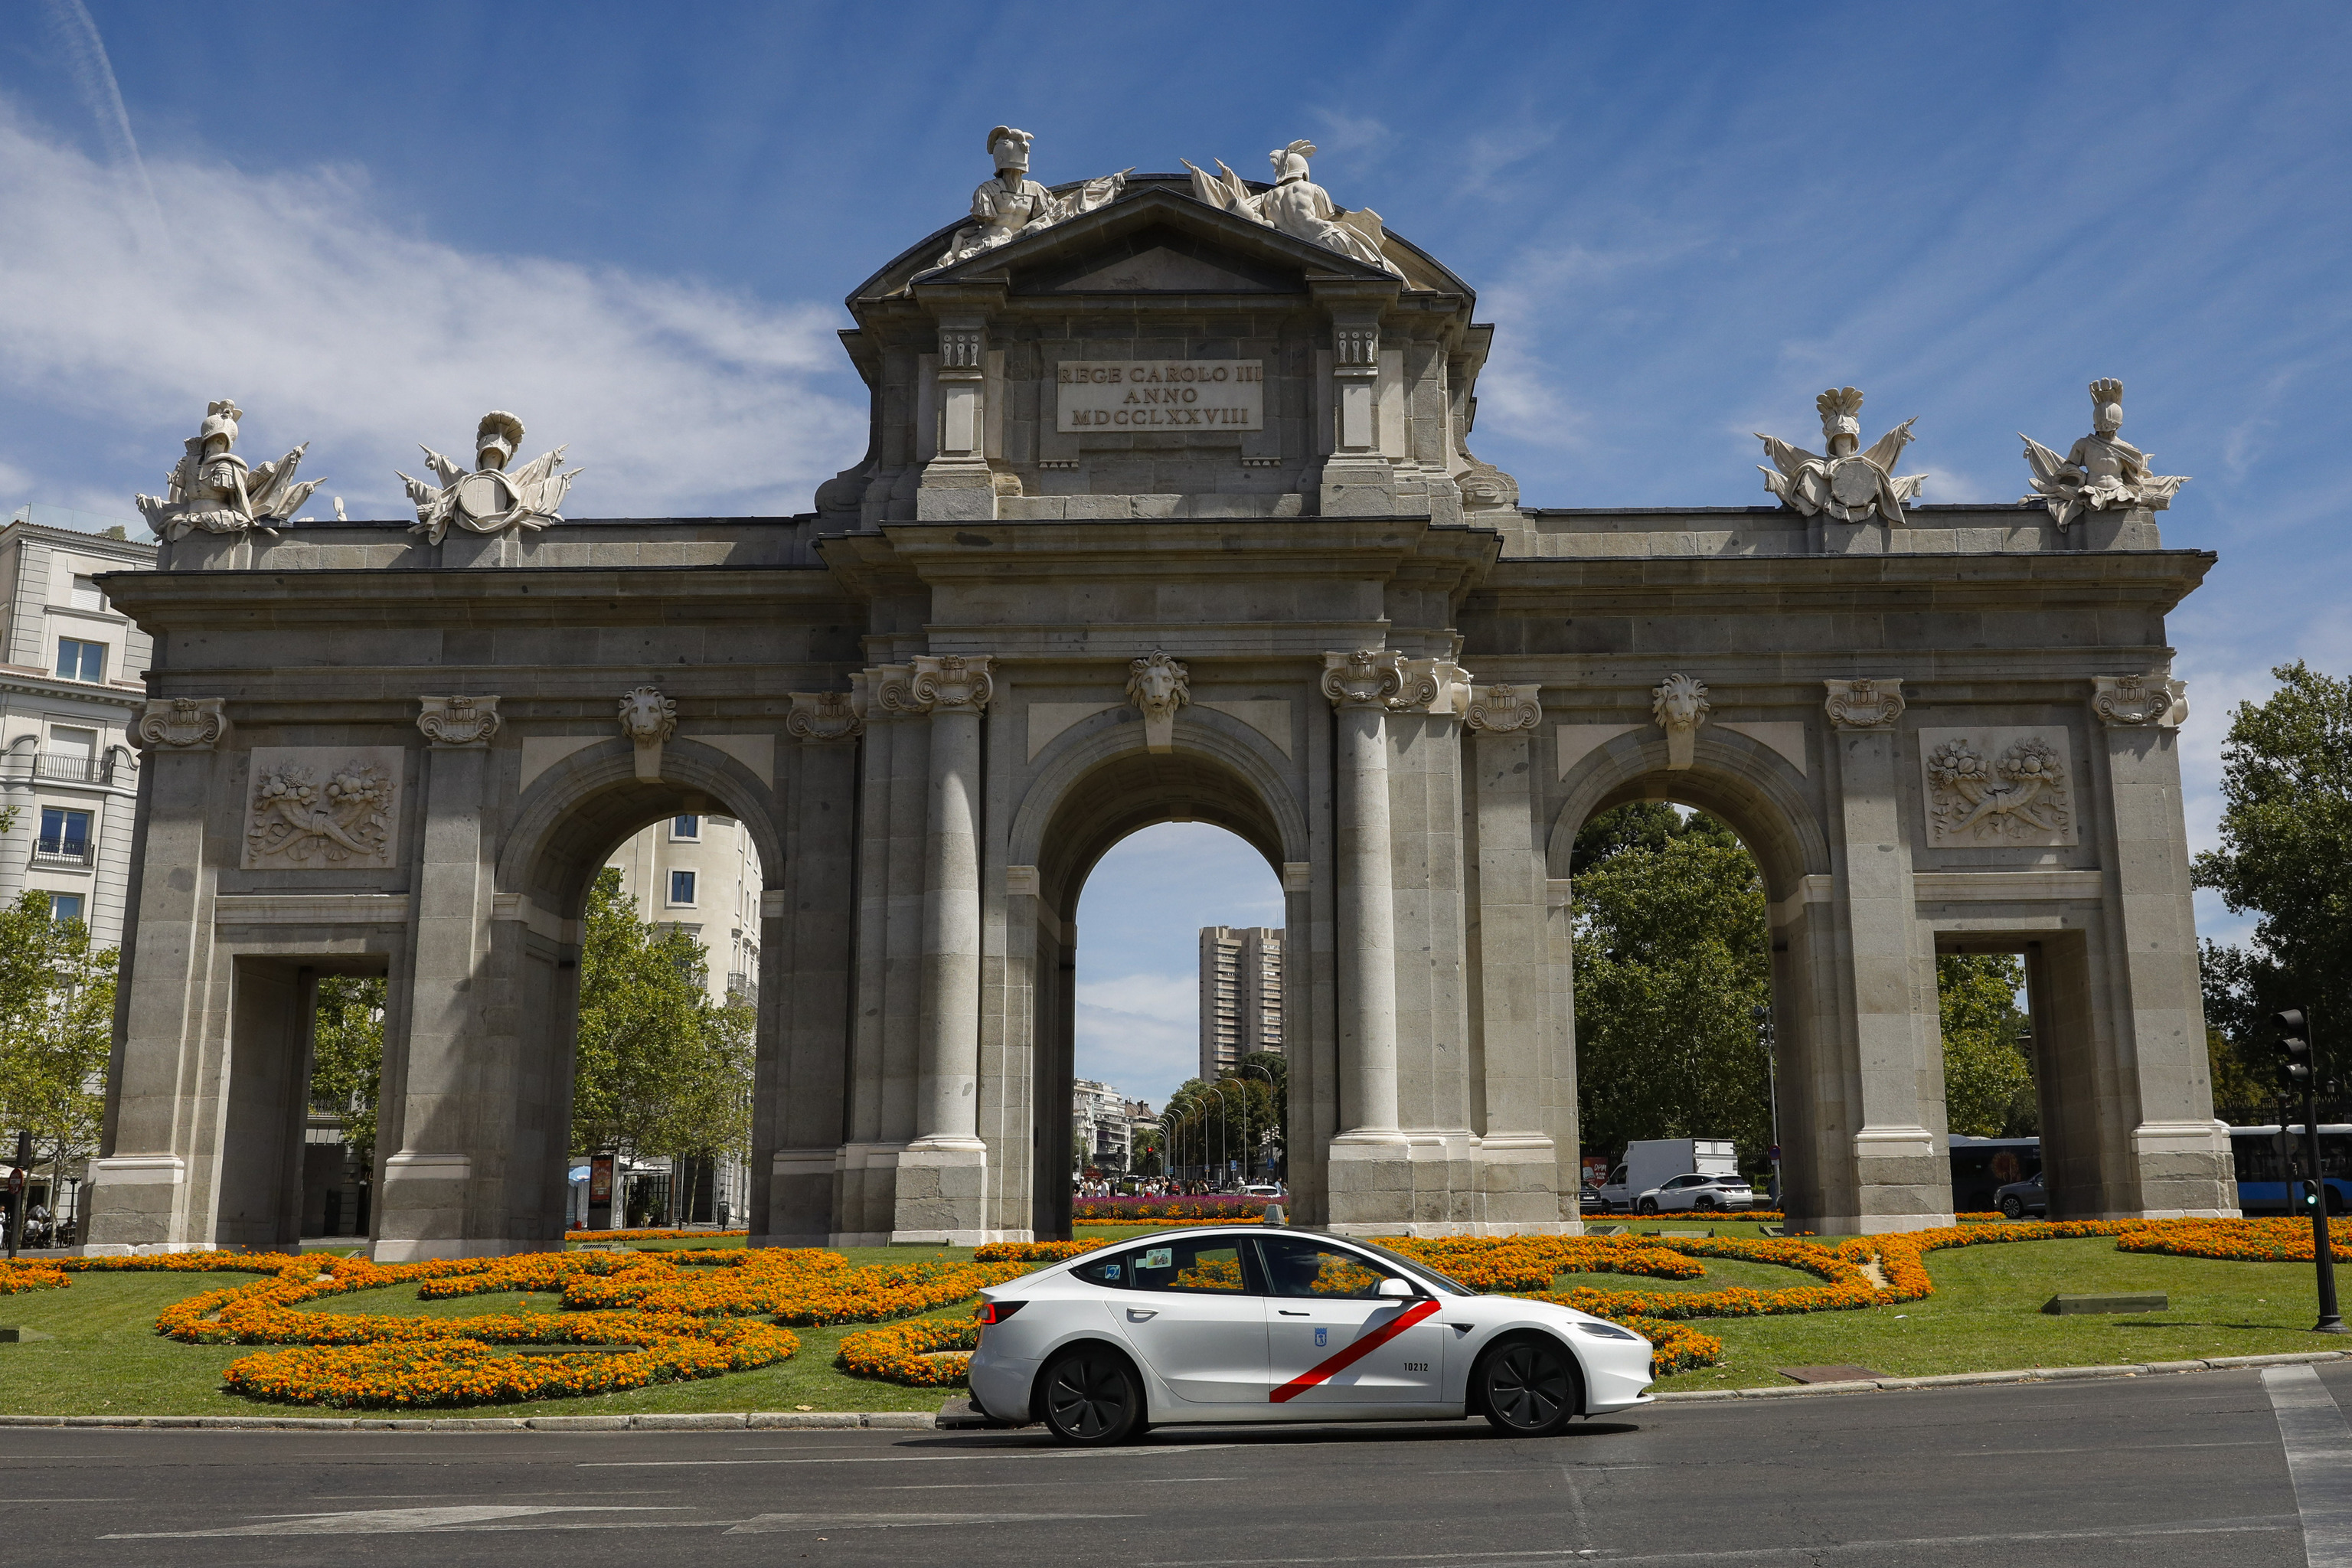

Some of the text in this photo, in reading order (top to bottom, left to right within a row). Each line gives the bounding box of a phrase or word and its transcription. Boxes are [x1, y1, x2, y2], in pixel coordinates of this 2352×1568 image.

[1058, 366, 1263, 384] REGE CAROLO III
[1123, 387, 1198, 403] ANNO
[1072, 408, 1249, 425] MDCCLXXVIII
[1404, 1363, 1429, 1371] 10212
